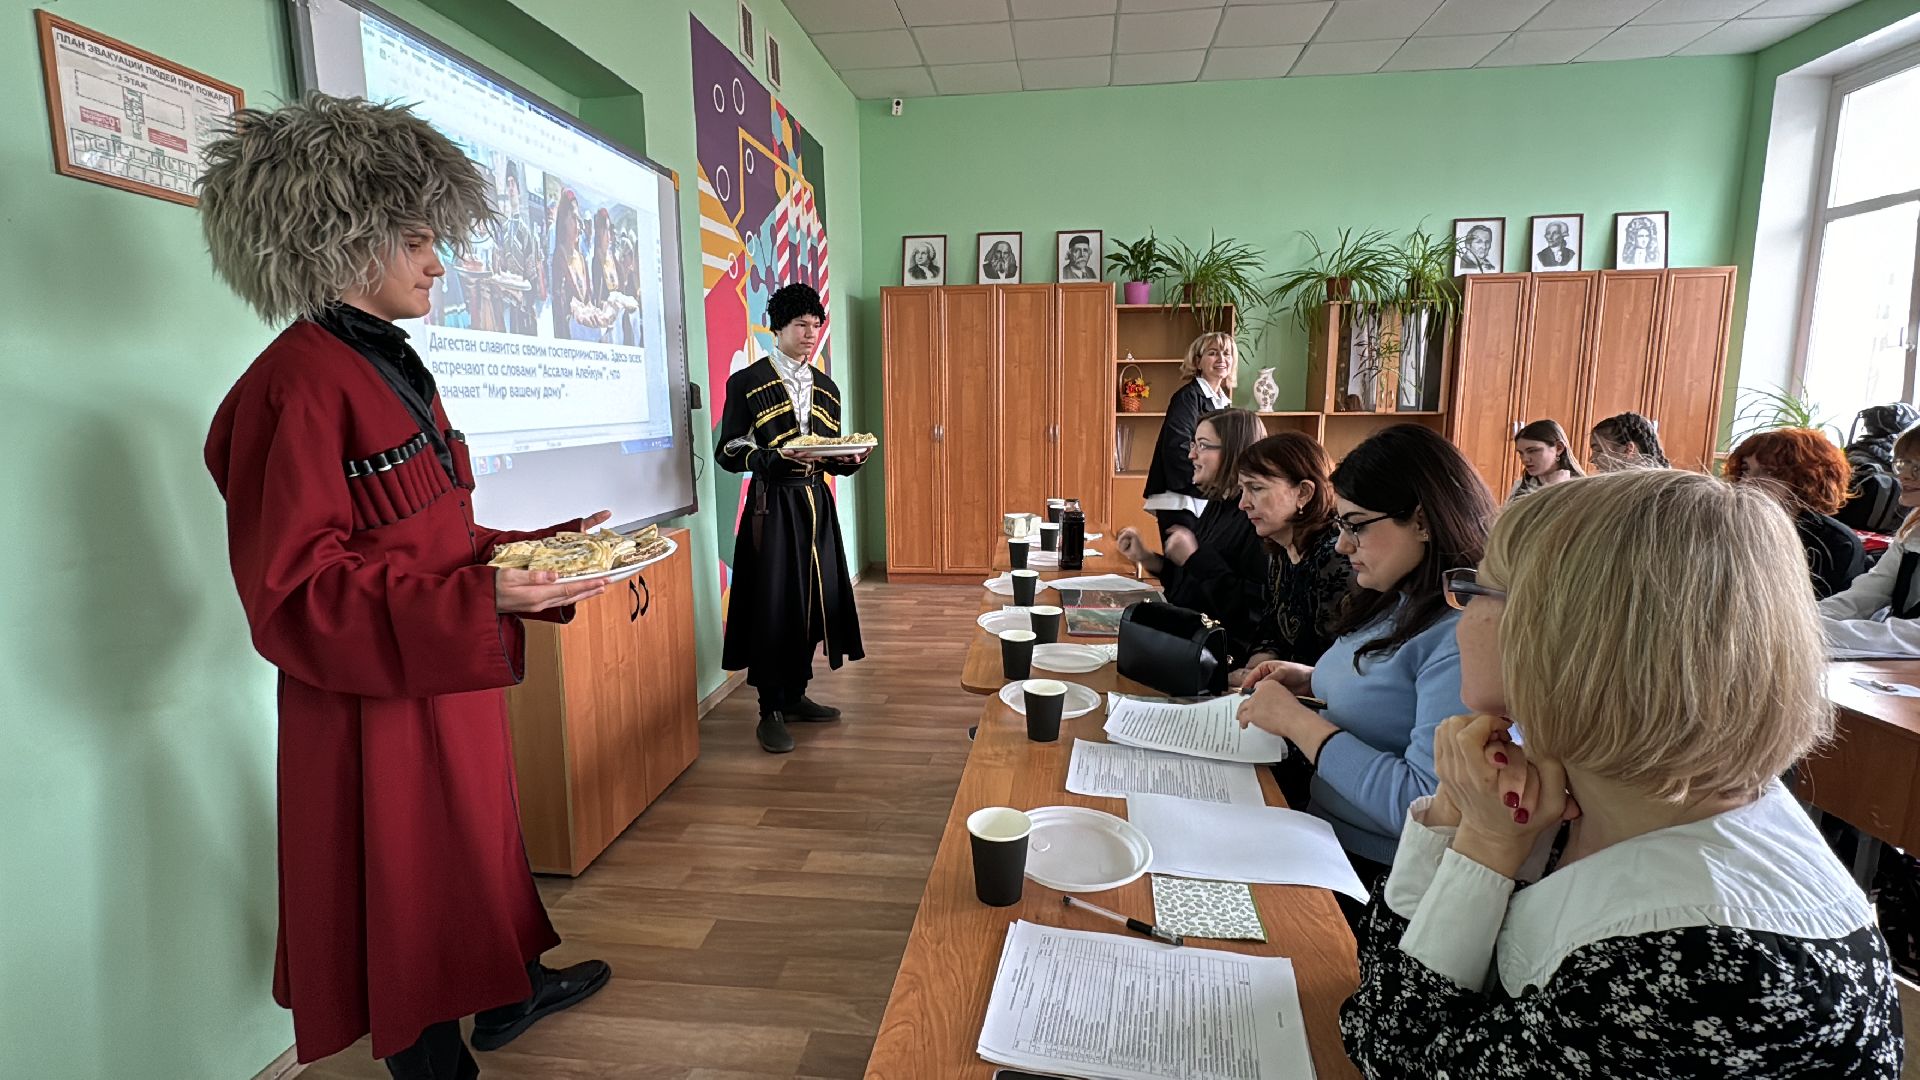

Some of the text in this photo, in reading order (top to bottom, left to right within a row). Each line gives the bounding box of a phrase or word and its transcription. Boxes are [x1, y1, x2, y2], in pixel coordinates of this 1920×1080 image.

[56, 32, 86, 50] ПЛАН
[87, 44, 144, 71] ЭВАКУАЦИИ
[145, 66, 177, 84] ЛЮДЕЙ
[178, 78, 194, 91] ПРИ
[123, 75, 149, 91] ЭТАЖ
[429, 331, 477, 352] Дагестан
[479, 340, 520, 355] славится
[522, 344, 547, 357] своим
[432, 361, 485, 377] встречают
[487, 363, 499, 375] со
[500, 364, 537, 377] словами
[440, 385, 480, 399] значает
[509, 386, 541, 400] вашему
